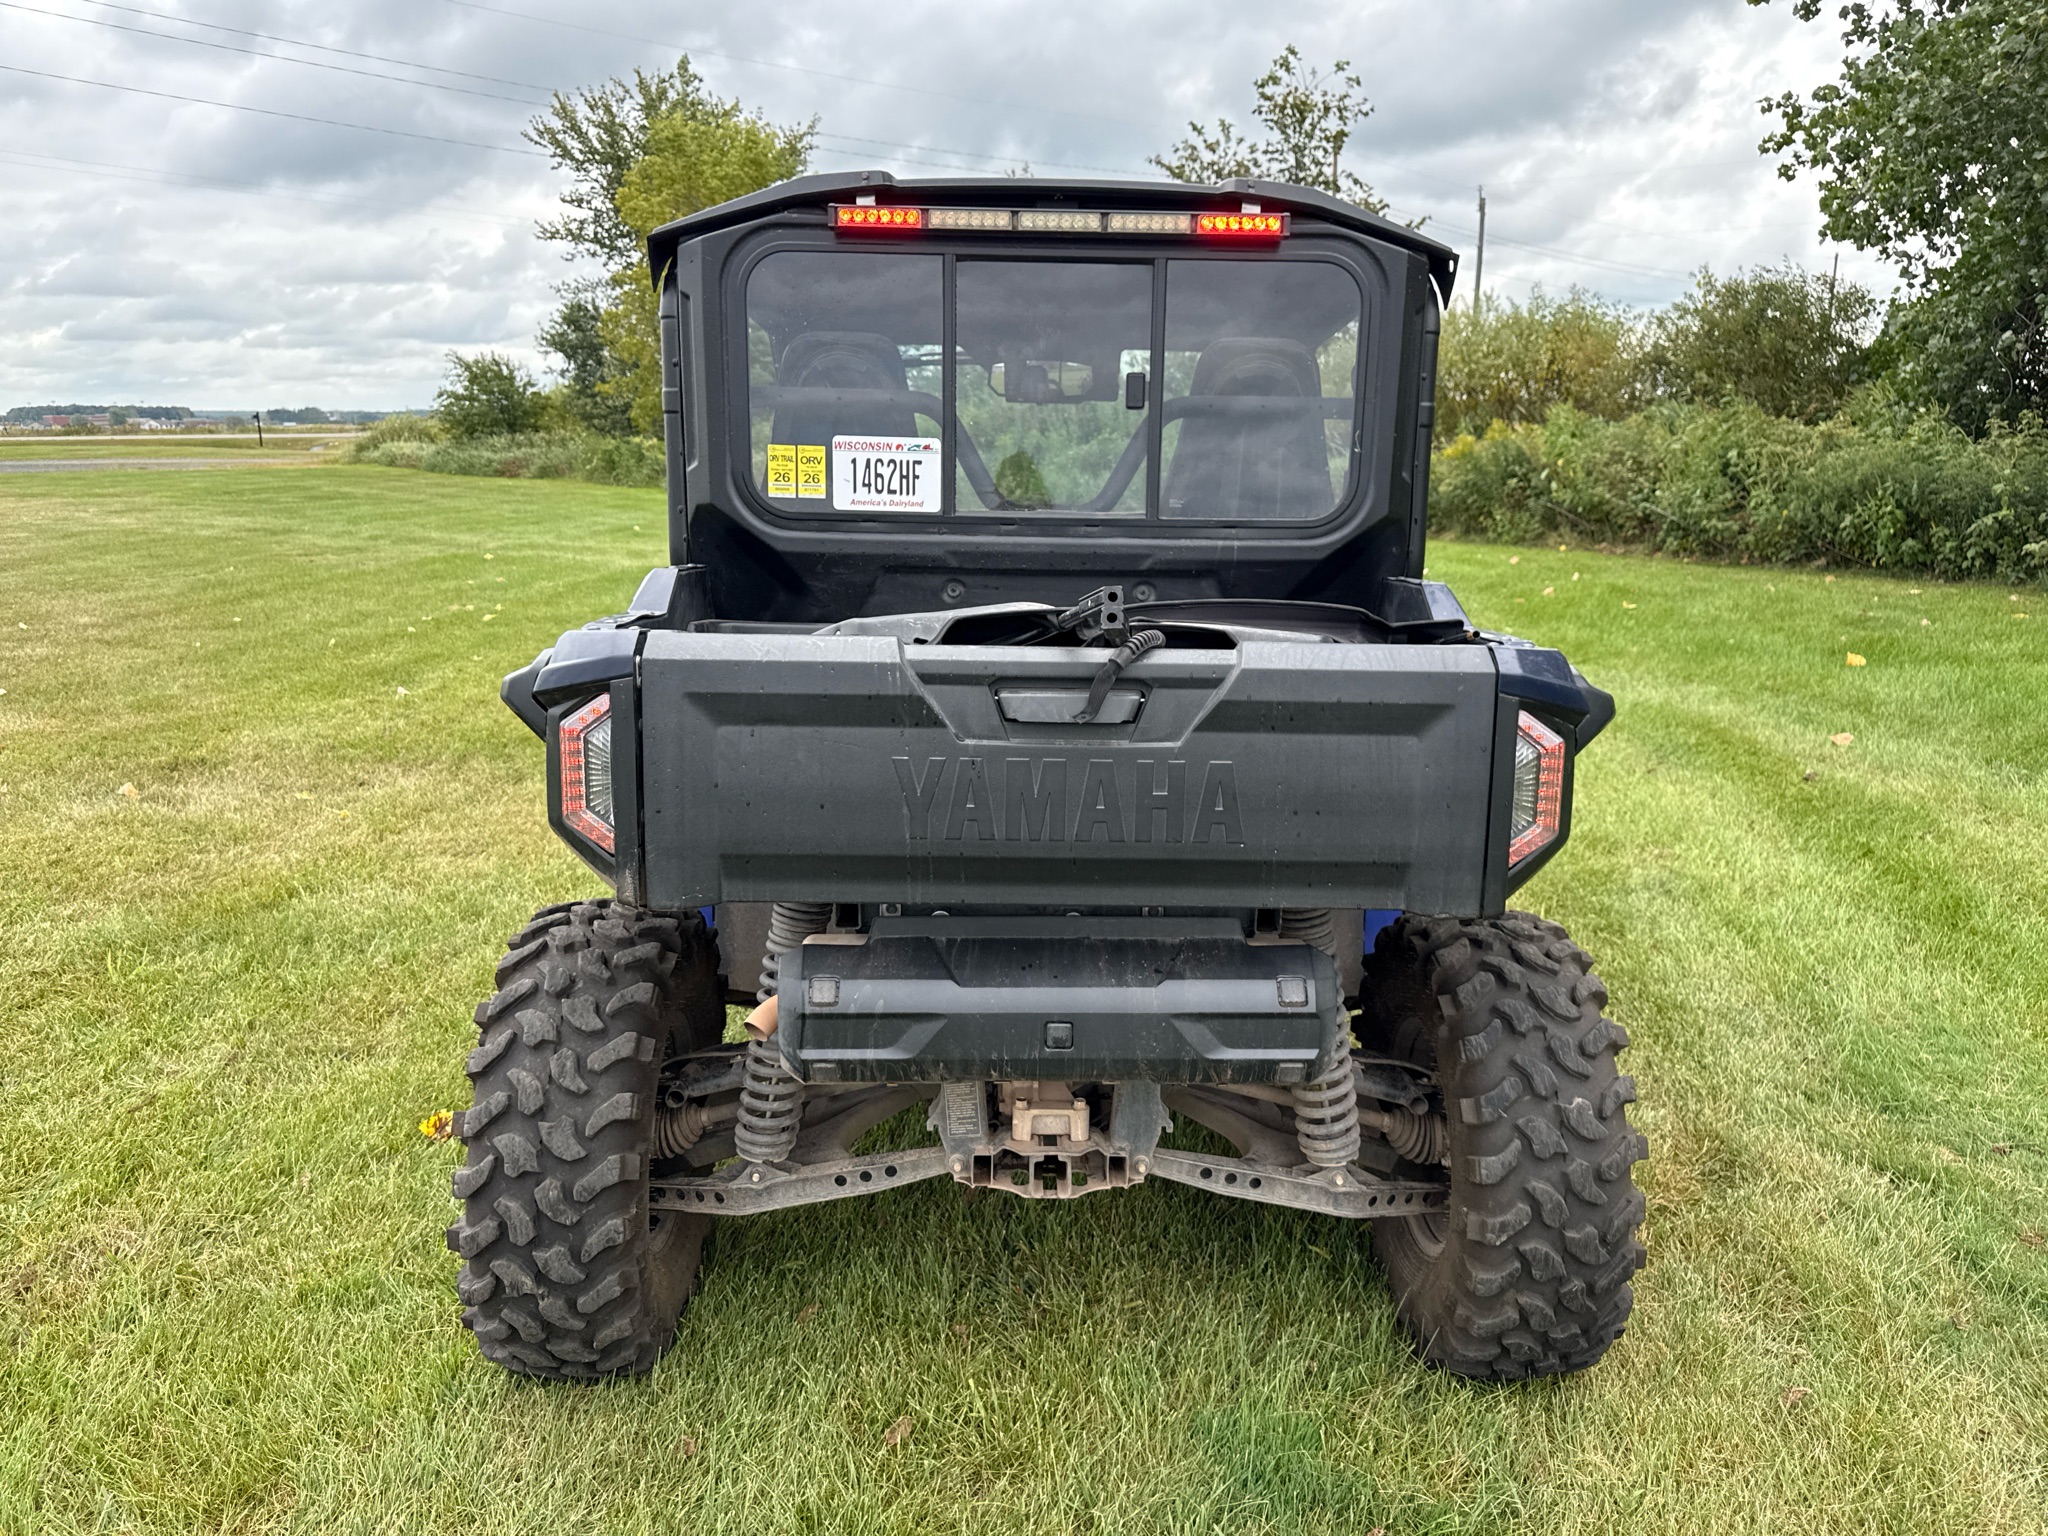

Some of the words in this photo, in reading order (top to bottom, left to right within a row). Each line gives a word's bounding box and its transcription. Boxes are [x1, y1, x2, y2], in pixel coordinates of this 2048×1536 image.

[834, 441, 892, 451] WISCONSIN
[800, 456, 823, 465] ORV
[774, 472, 790, 482] 26
[804, 473, 820, 484] 26
[851, 457, 922, 496] 1462HF
[889, 500, 924, 508] Dairyland
[892, 757, 1244, 844] YAMAHA
